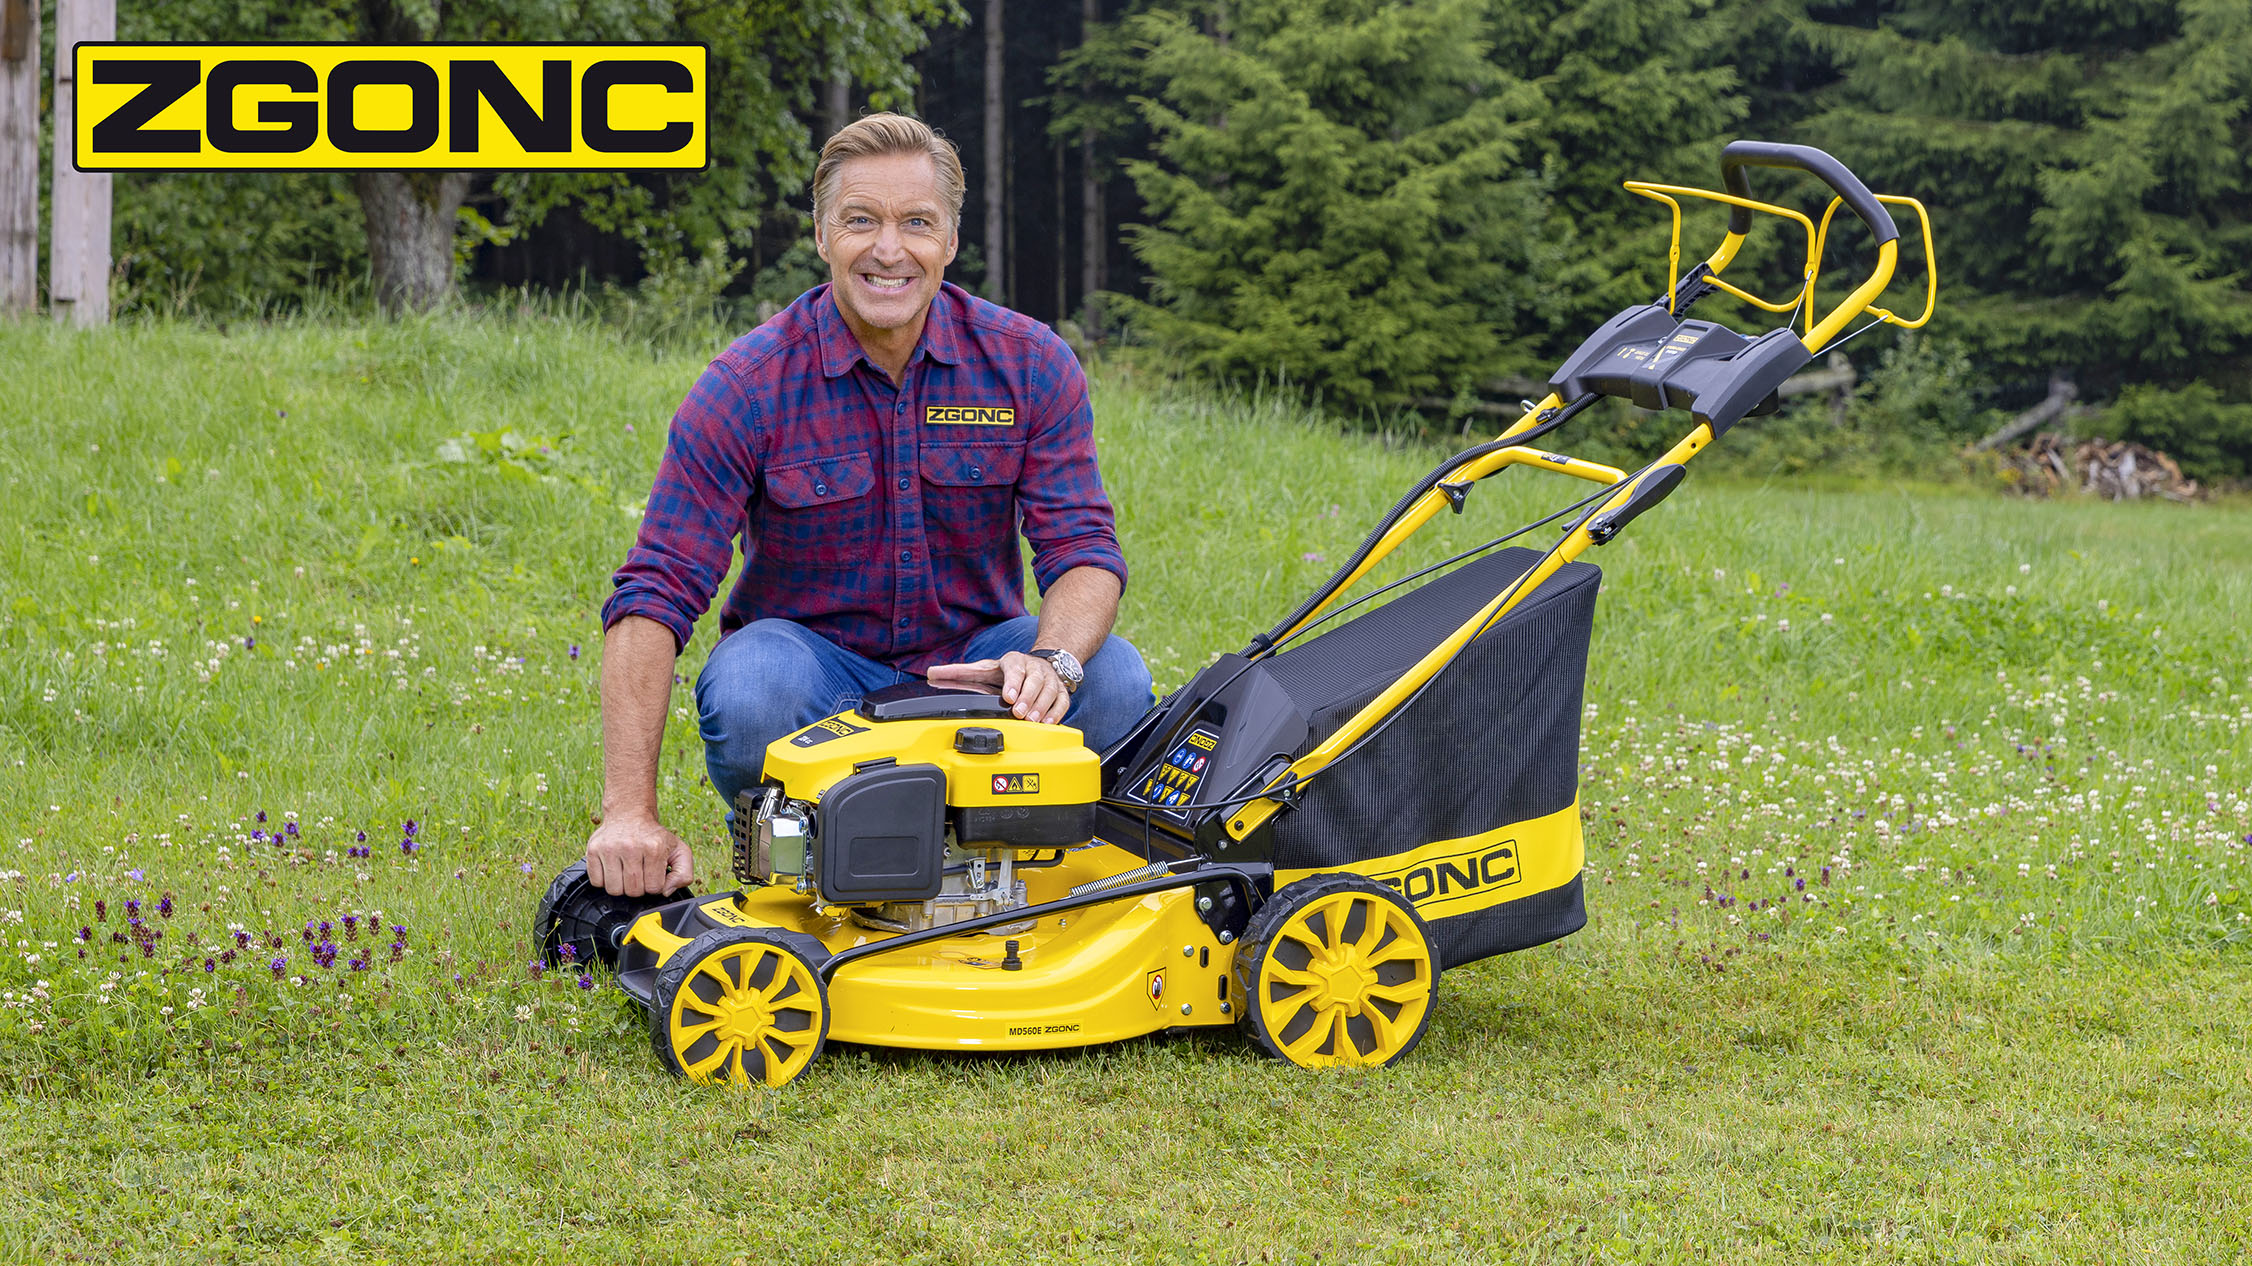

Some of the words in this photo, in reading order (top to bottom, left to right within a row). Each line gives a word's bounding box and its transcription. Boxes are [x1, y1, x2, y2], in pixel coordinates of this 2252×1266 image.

[929, 408, 1013, 423] ZGONC
[1009, 1026, 1042, 1036] MD560E
[1044, 1024, 1080, 1033] ZGONC
